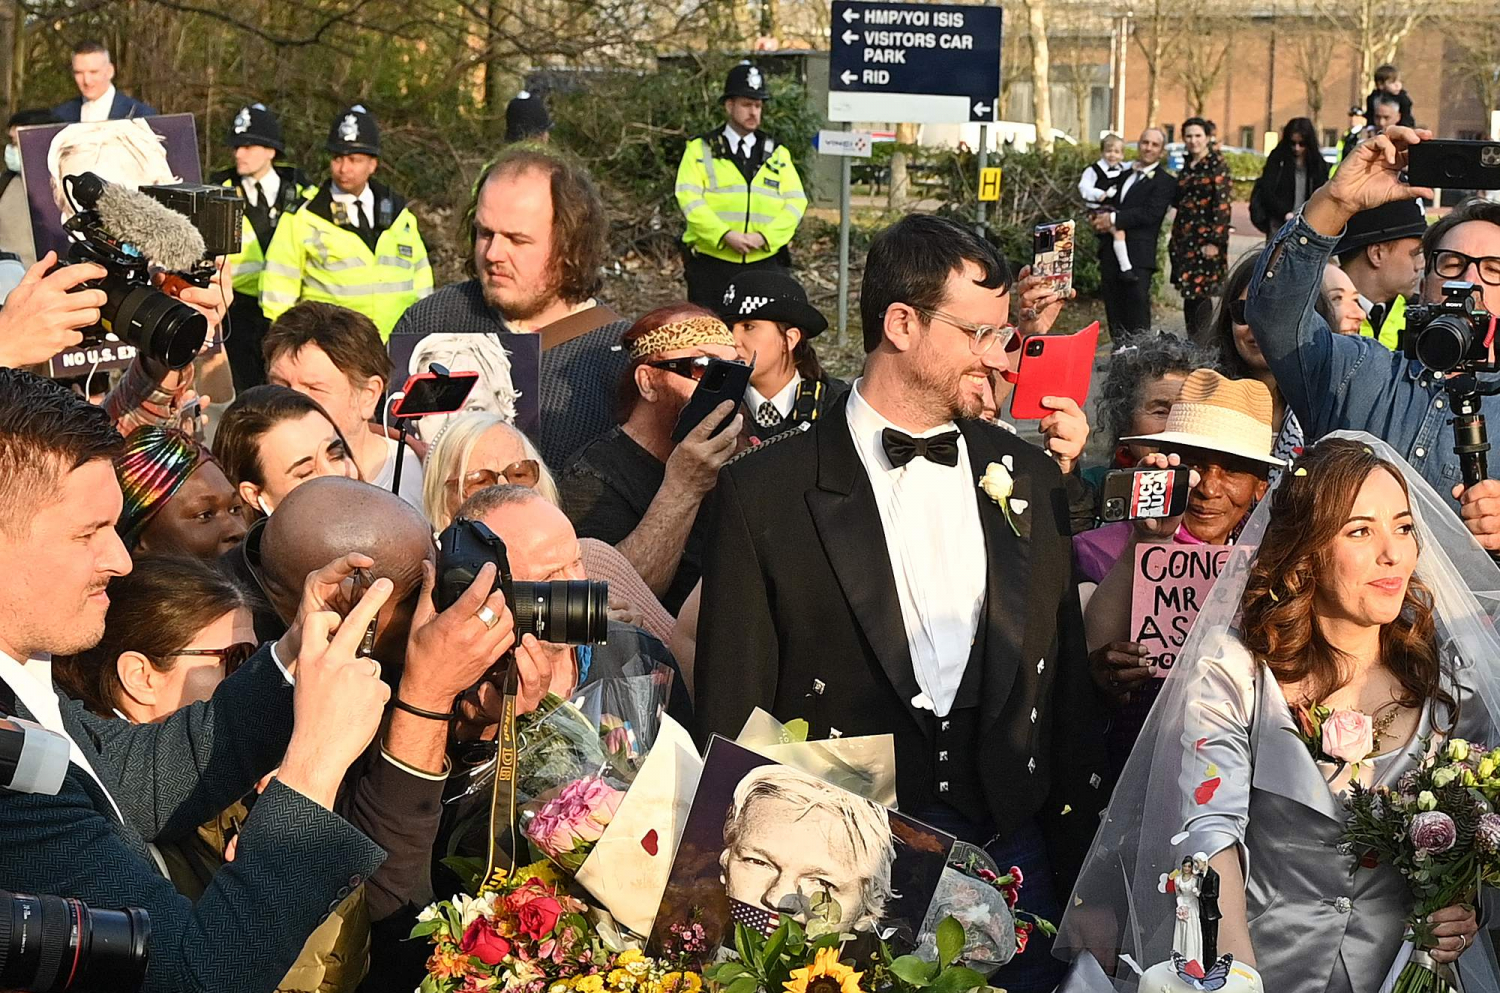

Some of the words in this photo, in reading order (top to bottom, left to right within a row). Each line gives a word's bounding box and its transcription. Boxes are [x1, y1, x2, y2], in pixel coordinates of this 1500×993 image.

[864, 9, 930, 27] HMP/YOI
[933, 12, 965, 28] ISIS
[864, 31, 937, 49] VISITORS
[939, 34, 974, 50] CAR
[863, 48, 907, 64] PARK
[862, 69, 891, 85] RID
[982, 172, 998, 196] H
[62, 351, 86, 368] NO
[1154, 585, 1200, 616] MR
